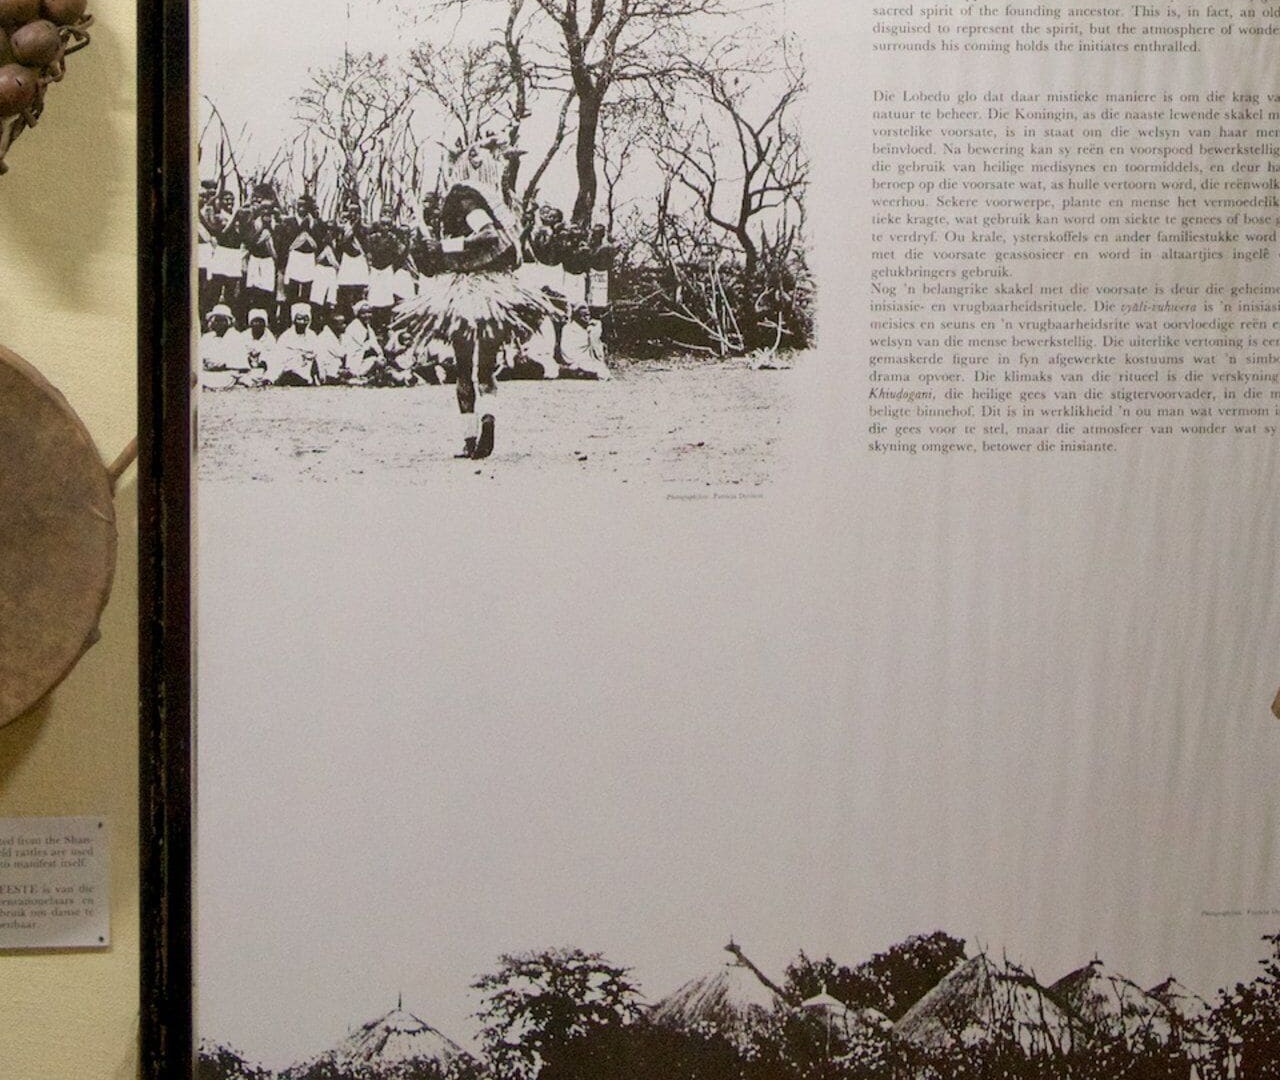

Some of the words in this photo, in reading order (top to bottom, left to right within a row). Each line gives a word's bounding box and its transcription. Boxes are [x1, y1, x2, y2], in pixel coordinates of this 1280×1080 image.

[873, 38, 936, 51] surrounds
[942, 39, 960, 51] his
[964, 39, 1011, 54] coming
[1016, 39, 1050, 51] holds
[1055, 39, 1074, 51] the
[1079, 39, 1129, 51] initiates
[1134, 39, 1202, 52] enthralled.
[874, 89, 895, 101] Die
[903, 89, 951, 101] Lobedu
[958, 89, 977, 105] glo
[984, 89, 1004, 102] dat
[1011, 89, 1040, 102] daar
[1047, 90, 1099, 102] mistieke
[1106, 90, 1157, 102] maniere
[1161, 90, 1173, 102] is
[1180, 93, 1200, 102] om
[1207, 90, 1226, 102] die
[1233, 90, 1260, 106] krag
[871, 265, 957, 281] gelukbringers
[962, 265, 1012, 281] gebruik.
[869, 439, 917, 455] skyning
[922, 443, 977, 455] omgewe,
[983, 439, 1032, 452] betower
[1037, 439, 1056, 452] die
[1061, 439, 1117, 452] inisiante.
